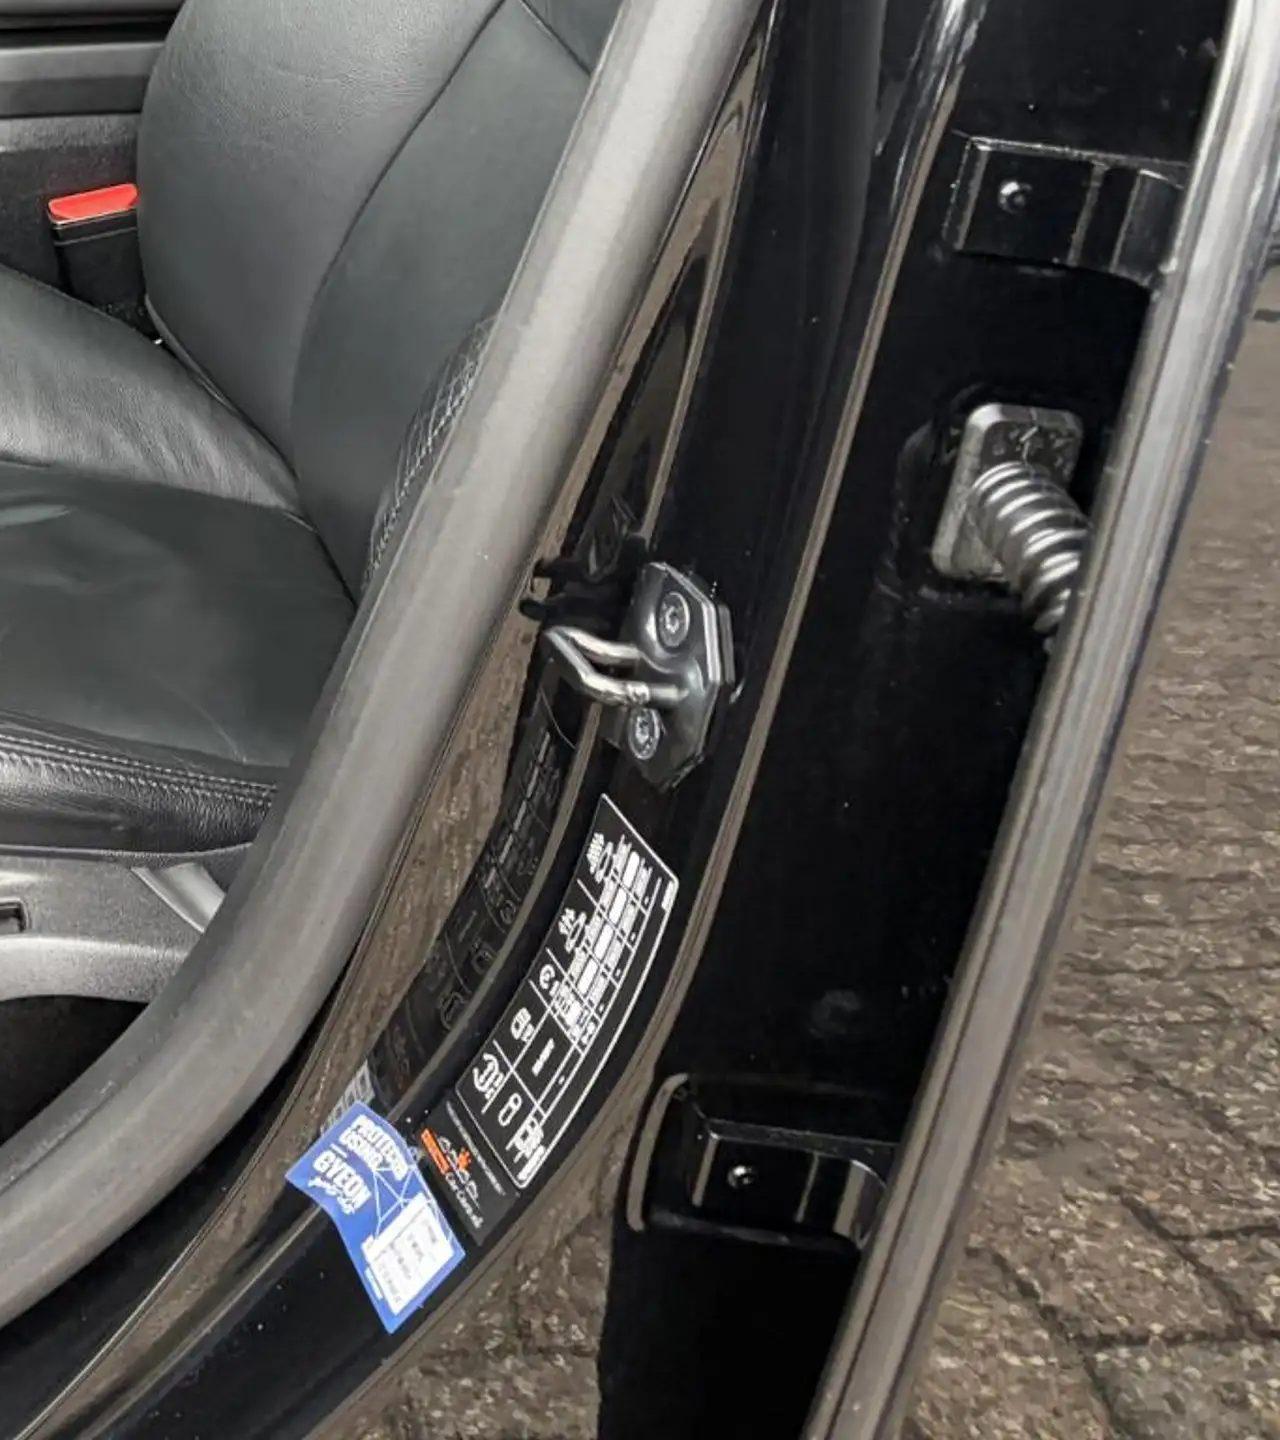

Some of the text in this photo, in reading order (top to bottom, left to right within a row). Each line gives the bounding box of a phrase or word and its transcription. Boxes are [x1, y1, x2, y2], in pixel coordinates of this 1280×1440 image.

[337, 1125, 383, 1171] USING
[350, 1113, 409, 1181] PROTECTED
[312, 1149, 372, 1210] GYEON
